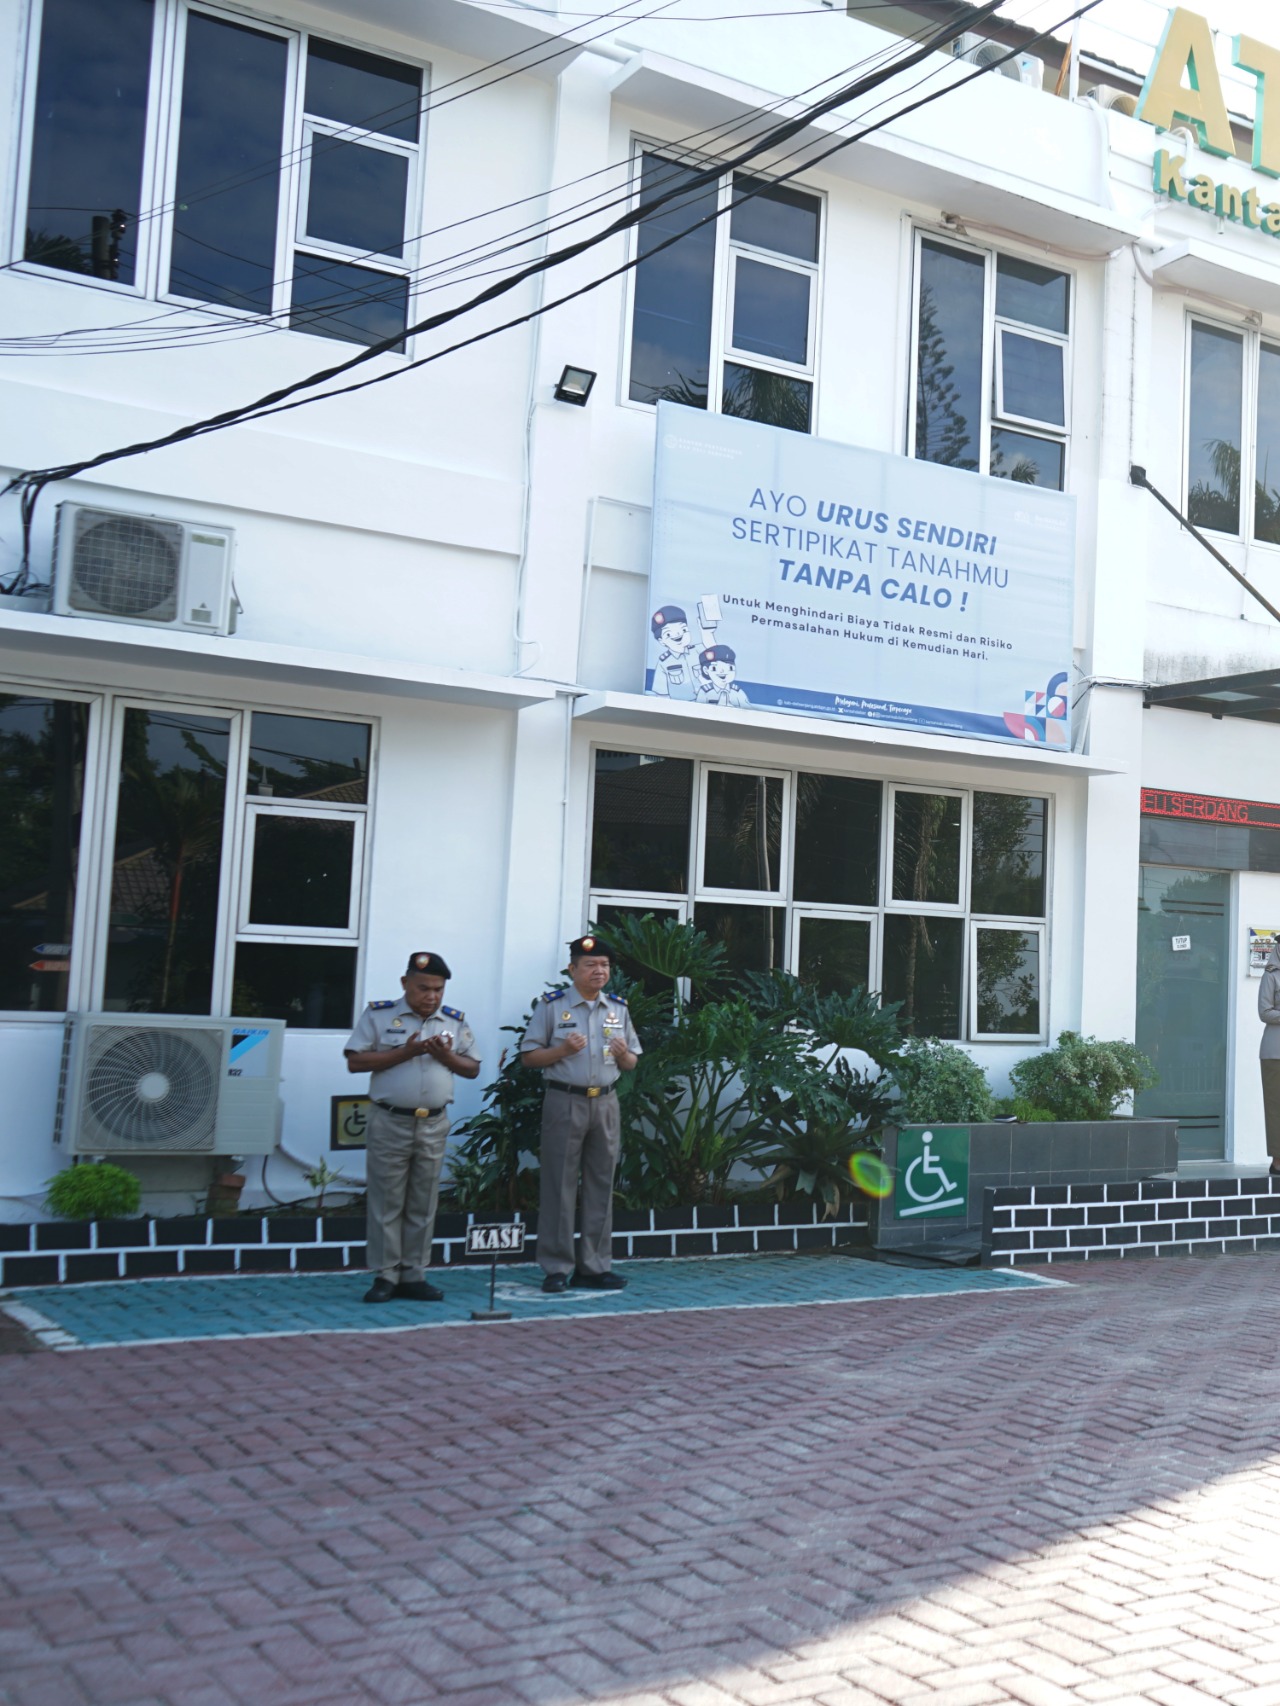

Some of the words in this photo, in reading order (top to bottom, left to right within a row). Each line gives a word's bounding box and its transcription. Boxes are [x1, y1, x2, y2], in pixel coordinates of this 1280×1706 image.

[749, 487, 807, 517] AYO
[817, 500, 889, 534] URUS
[896, 517, 997, 556] SENDIRI
[732, 517, 878, 564] SERTIPIKAT
[887, 546, 1009, 589] TANAHMU
[779, 558, 872, 596] TANPA
[722, 594, 761, 609] Untuk
[765, 601, 844, 622] Menghindari
[847, 614, 879, 629] Biaya
[883, 620, 915, 634] Tidak
[919, 626, 953, 640] Resmi
[956, 632, 977, 645] dan
[980, 637, 1013, 650] Risiko
[751, 614, 840, 637] Permasalahan
[843, 629, 884, 644] Hukum
[887, 636, 899, 646] di
[902, 638, 959, 656] Kemudian
[962, 649, 989, 661] Hari.
[1171, 796, 1249, 821] SERDANG
[471, 1228, 520, 1250] KASI
